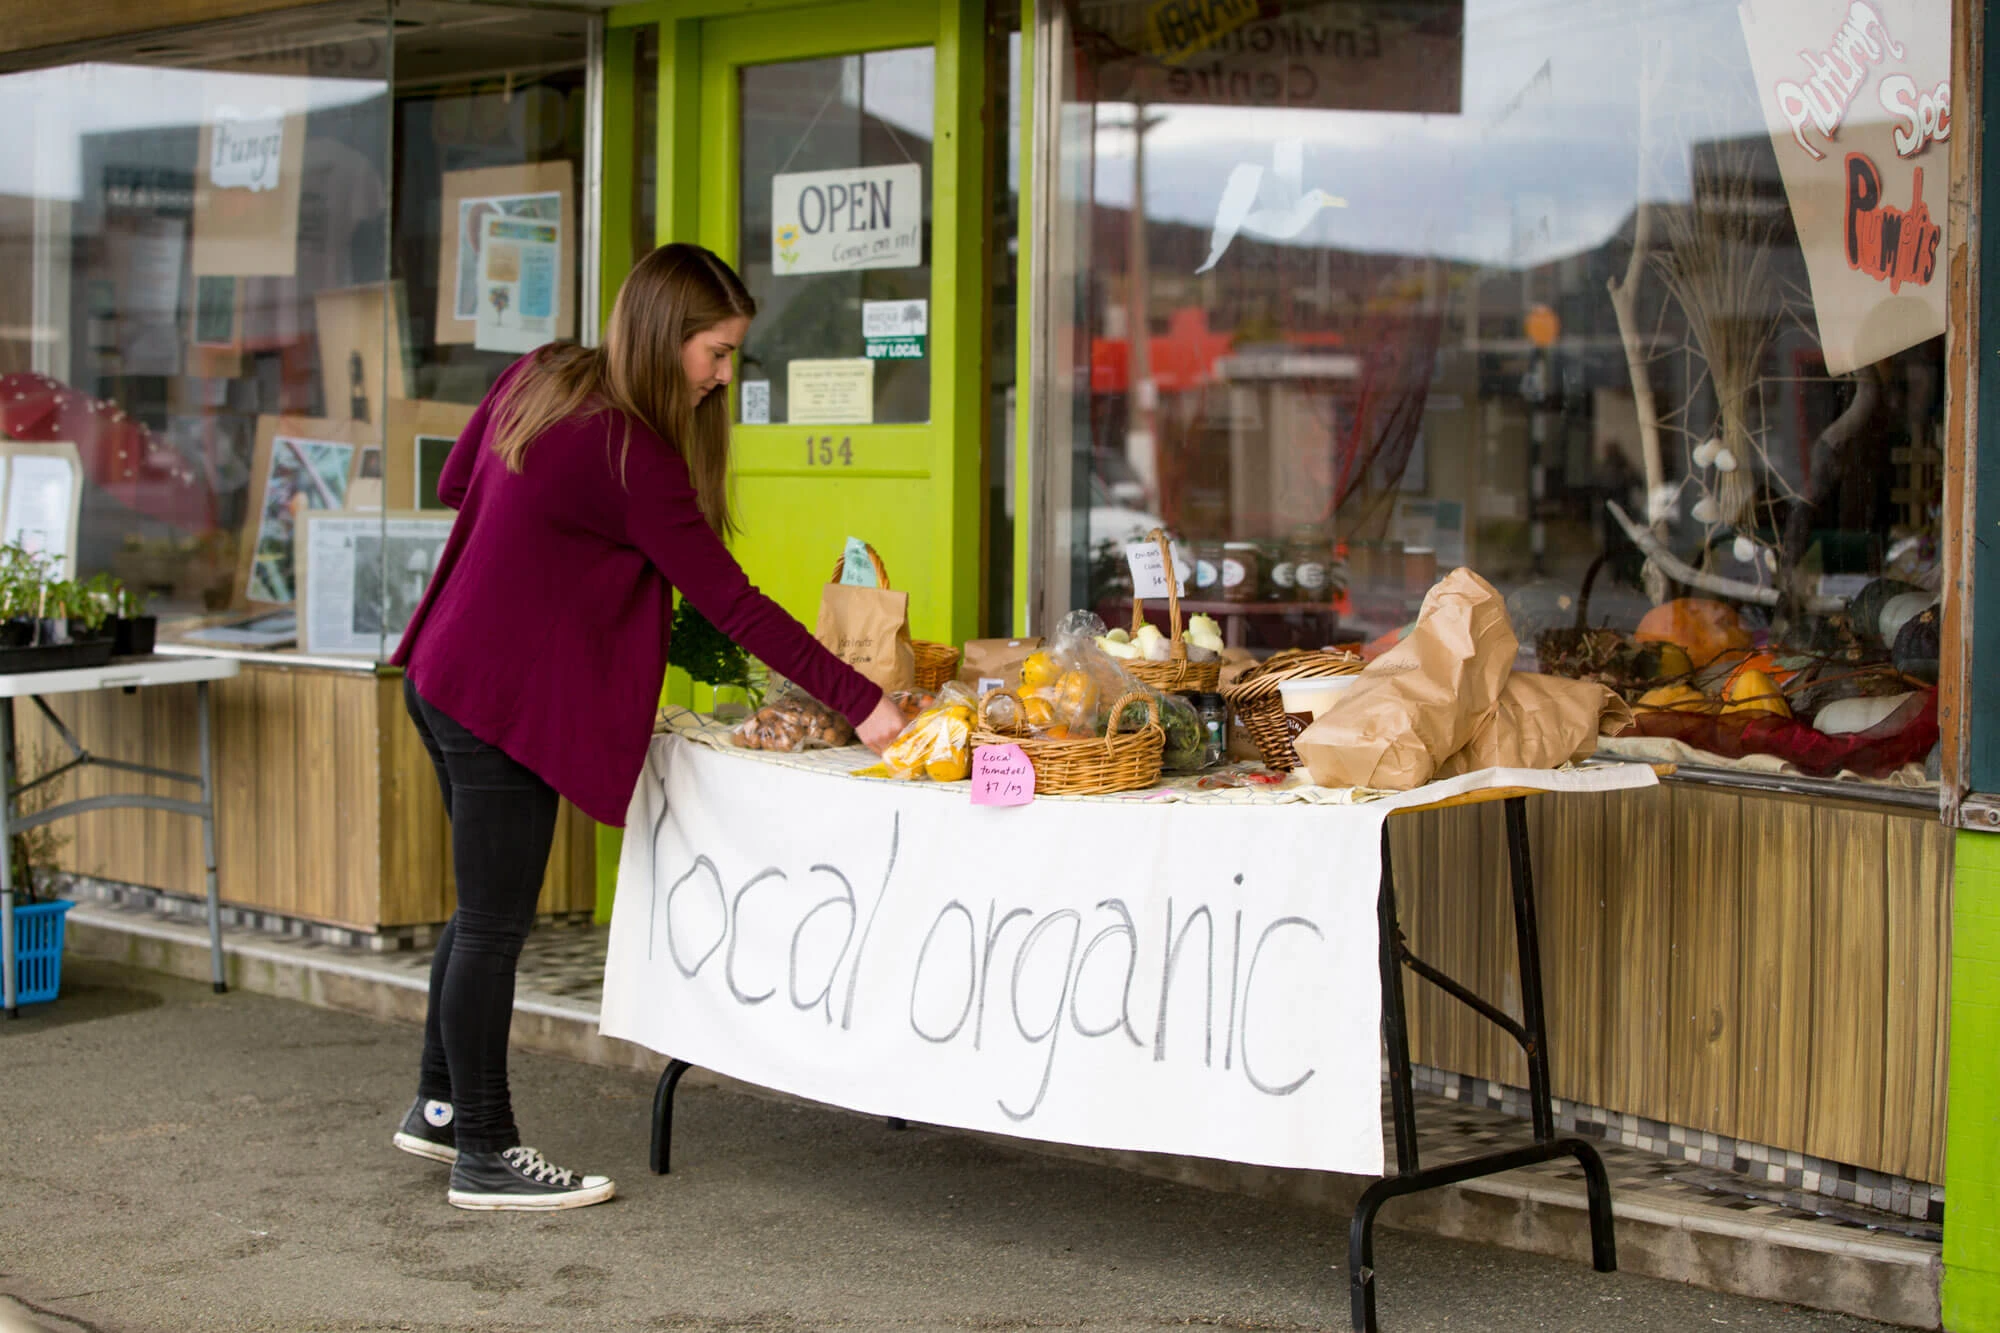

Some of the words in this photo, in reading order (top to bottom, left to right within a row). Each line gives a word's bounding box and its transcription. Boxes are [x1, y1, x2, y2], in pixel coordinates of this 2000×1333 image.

[1775, 0, 1904, 160] Autumn
[215, 119, 283, 181] Fungi
[797, 180, 892, 234] OPEN
[832, 243, 868, 262] Come
[872, 238, 890, 252] on
[866, 344, 887, 357] BUY
[889, 344, 922, 357] LOCAL
[807, 436, 853, 466] 154
[982, 752, 1011, 761] Local
[986, 782, 999, 794] $7
[649, 777, 899, 1030] local
[910, 872, 1326, 1121] organic
